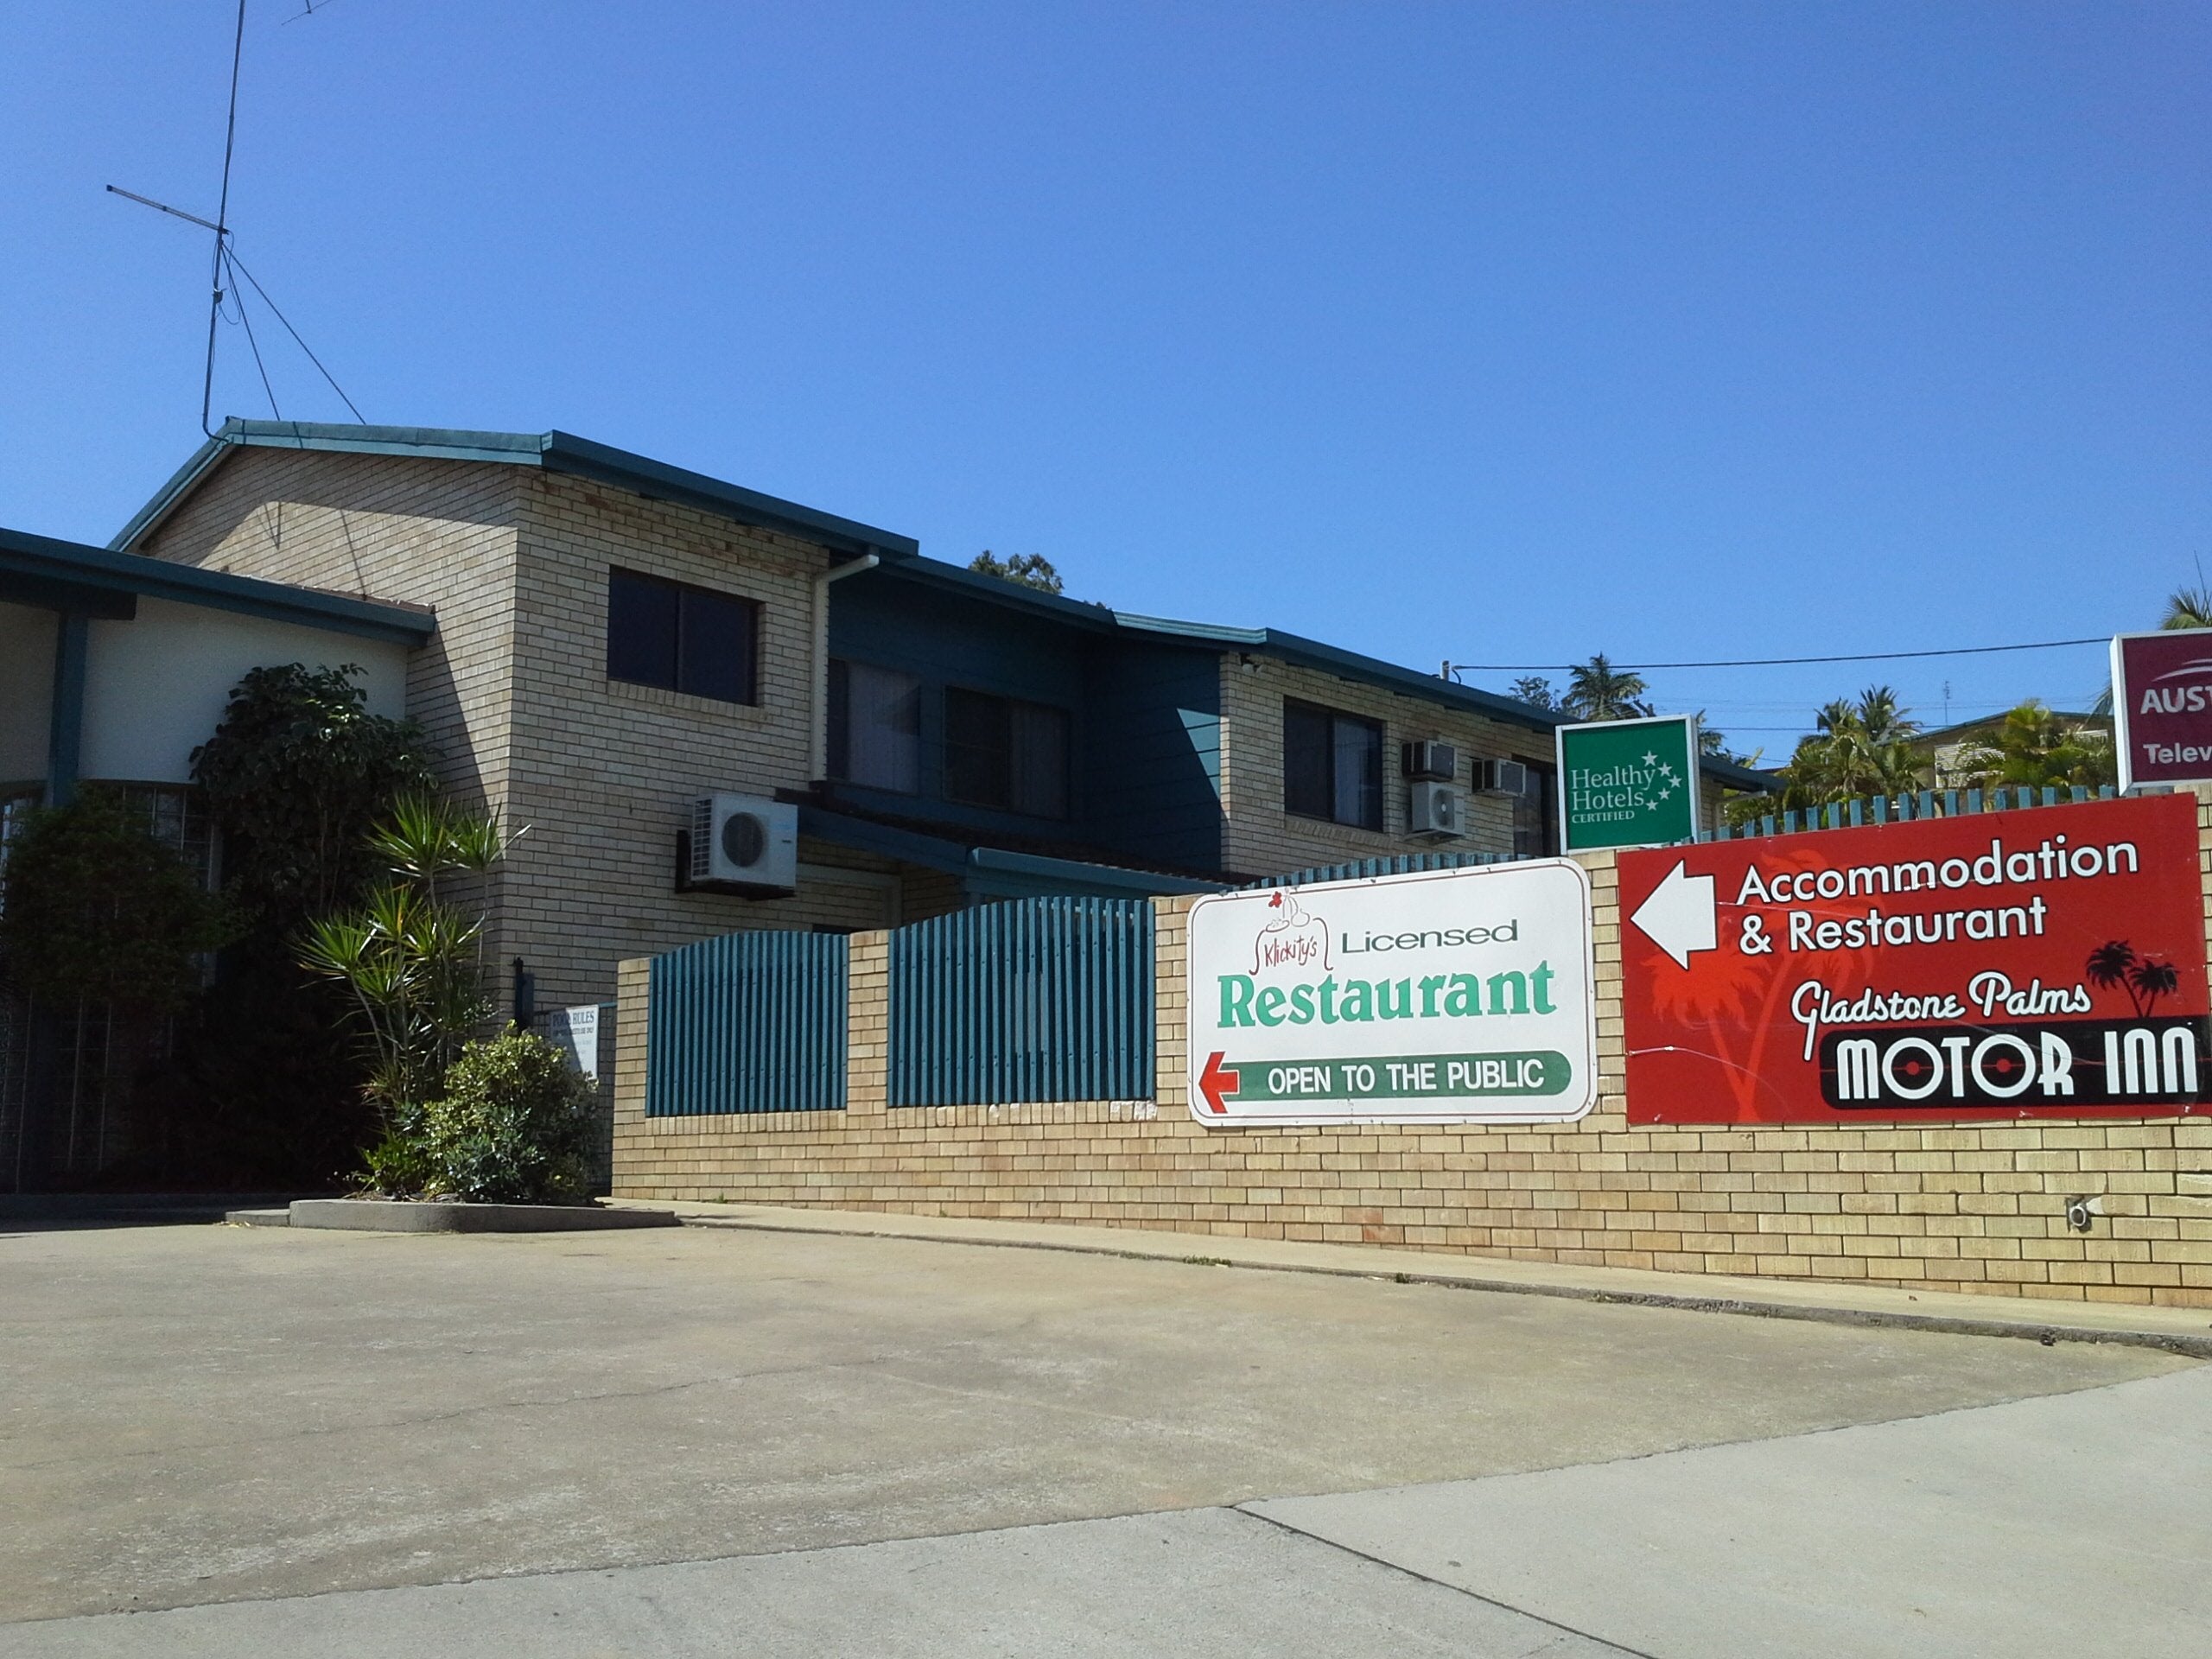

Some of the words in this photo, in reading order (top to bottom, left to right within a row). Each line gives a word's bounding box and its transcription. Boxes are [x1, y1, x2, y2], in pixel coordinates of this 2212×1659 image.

[2143, 742, 2212, 764] Telev
[1571, 765, 1656, 791] Healthy
[1572, 810, 1635, 823] CERTIFIED
[1573, 787, 1644, 810] Hotels
[1736, 835, 2138, 906] Accommodation
[1342, 918, 1518, 954] Licensed
[1739, 915, 1772, 955] &
[1789, 897, 2047, 950] Restaurant
[1264, 935, 1318, 967] Klickity's
[1217, 961, 1556, 1028] Restaurant
[573, 1011, 594, 1025] RULES
[1791, 980, 1966, 1061] Gladstone
[1968, 971, 2092, 1017] Palms
[1268, 1065, 1332, 1095] OPEN
[1341, 1064, 1376, 1092] TO
[1385, 1062, 1438, 1091] THE
[1447, 1058, 1545, 1090] PUBLIC
[1836, 1031, 2075, 1100] MOTOR
[2104, 1027, 2198, 1094] INN
